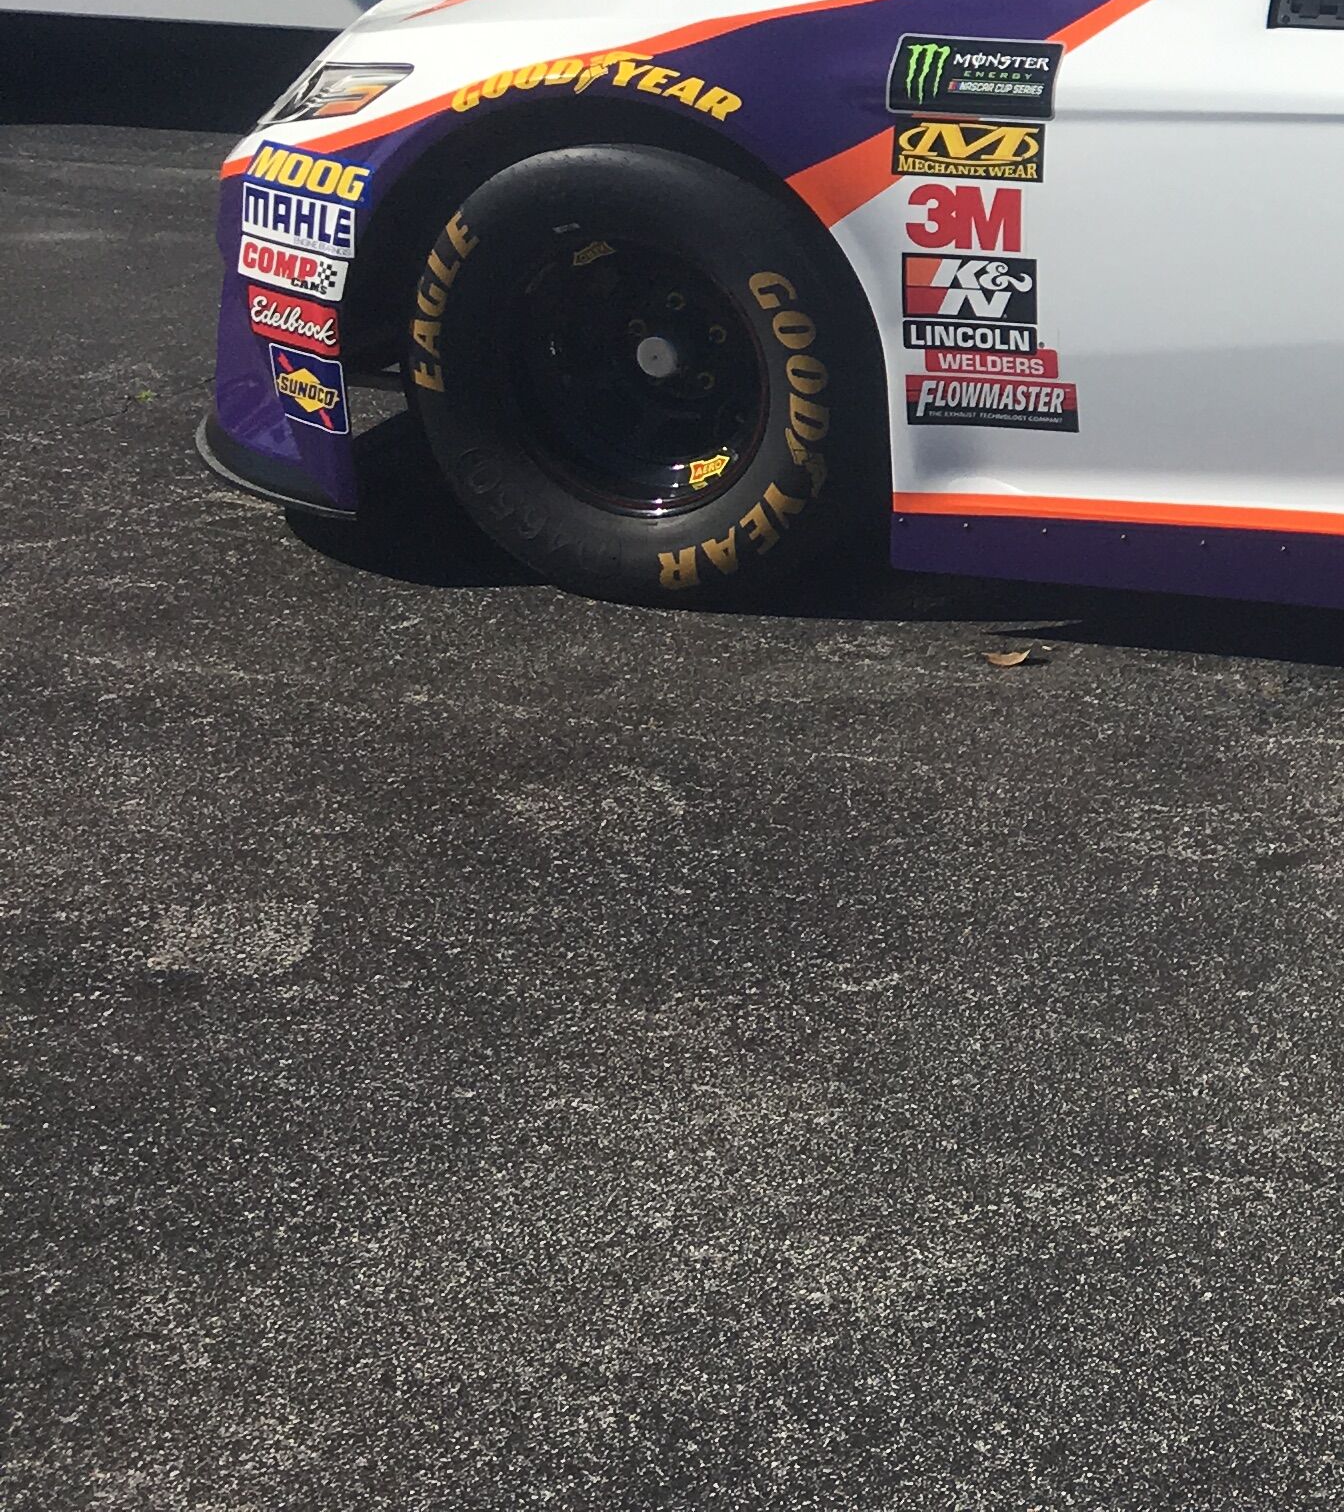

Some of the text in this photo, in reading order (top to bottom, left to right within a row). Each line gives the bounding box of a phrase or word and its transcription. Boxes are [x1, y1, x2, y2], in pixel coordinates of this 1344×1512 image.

[959, 81, 1045, 96] NASCAR CUP SERIES
[248, 145, 370, 202] MOOG
[897, 155, 1039, 180] MECHANIX WEAR
[244, 187, 352, 249] MAHLE
[905, 183, 1022, 253] 3M
[242, 241, 318, 280] COMP
[291, 276, 328, 295] CAMS
[412, 211, 481, 393] EAGLE
[250, 296, 336, 345] Edelbrock
[910, 324, 1031, 353] LINCOLN
[937, 352, 1045, 375] WELDERS
[280, 373, 336, 407] SUNOCO
[915, 380, 1065, 417] FLOWMASTER
[694, 458, 724, 478] AERO
